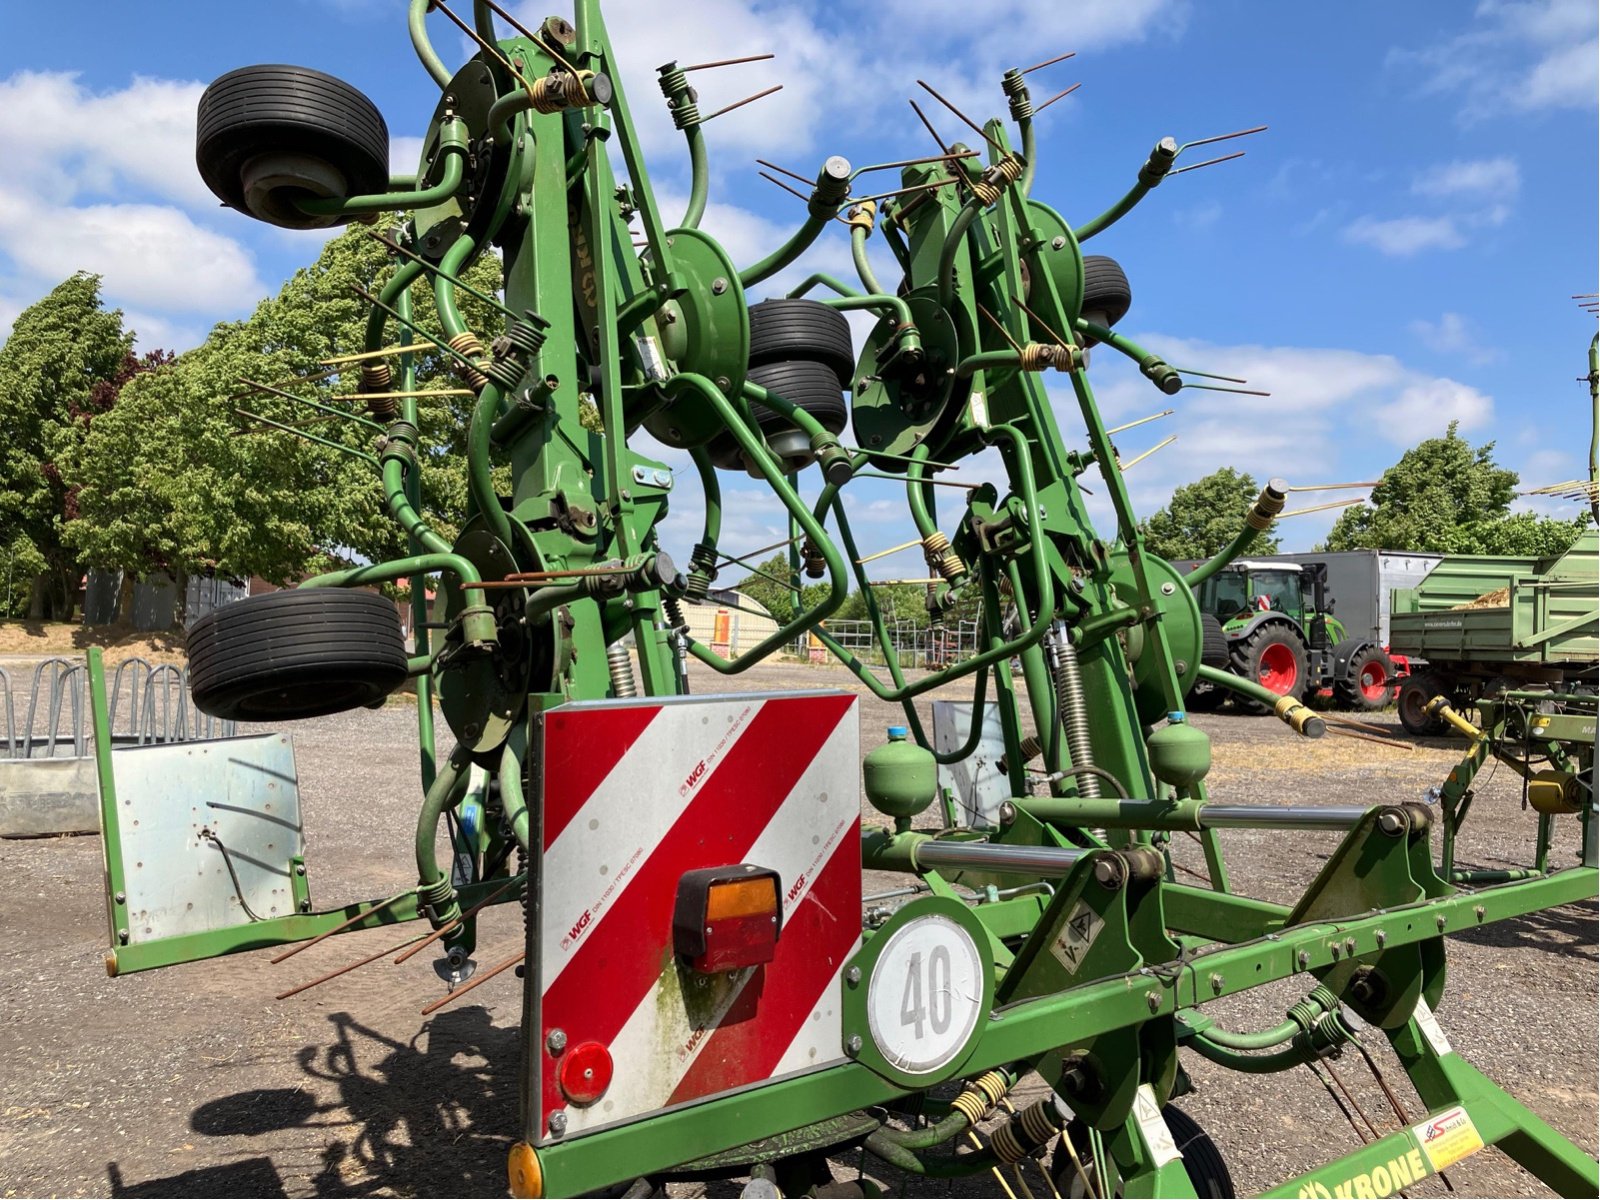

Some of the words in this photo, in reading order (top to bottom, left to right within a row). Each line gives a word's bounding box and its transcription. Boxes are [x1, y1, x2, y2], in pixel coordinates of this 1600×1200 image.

[686, 759, 706, 788] WGF
[788, 873, 806, 902] WGF
[568, 908, 592, 940] WGF
[592, 900, 603, 914] DIN
[900, 944, 952, 1040] 40
[685, 1022, 706, 1052] WGF
[1334, 1148, 1427, 1199] KRONE
